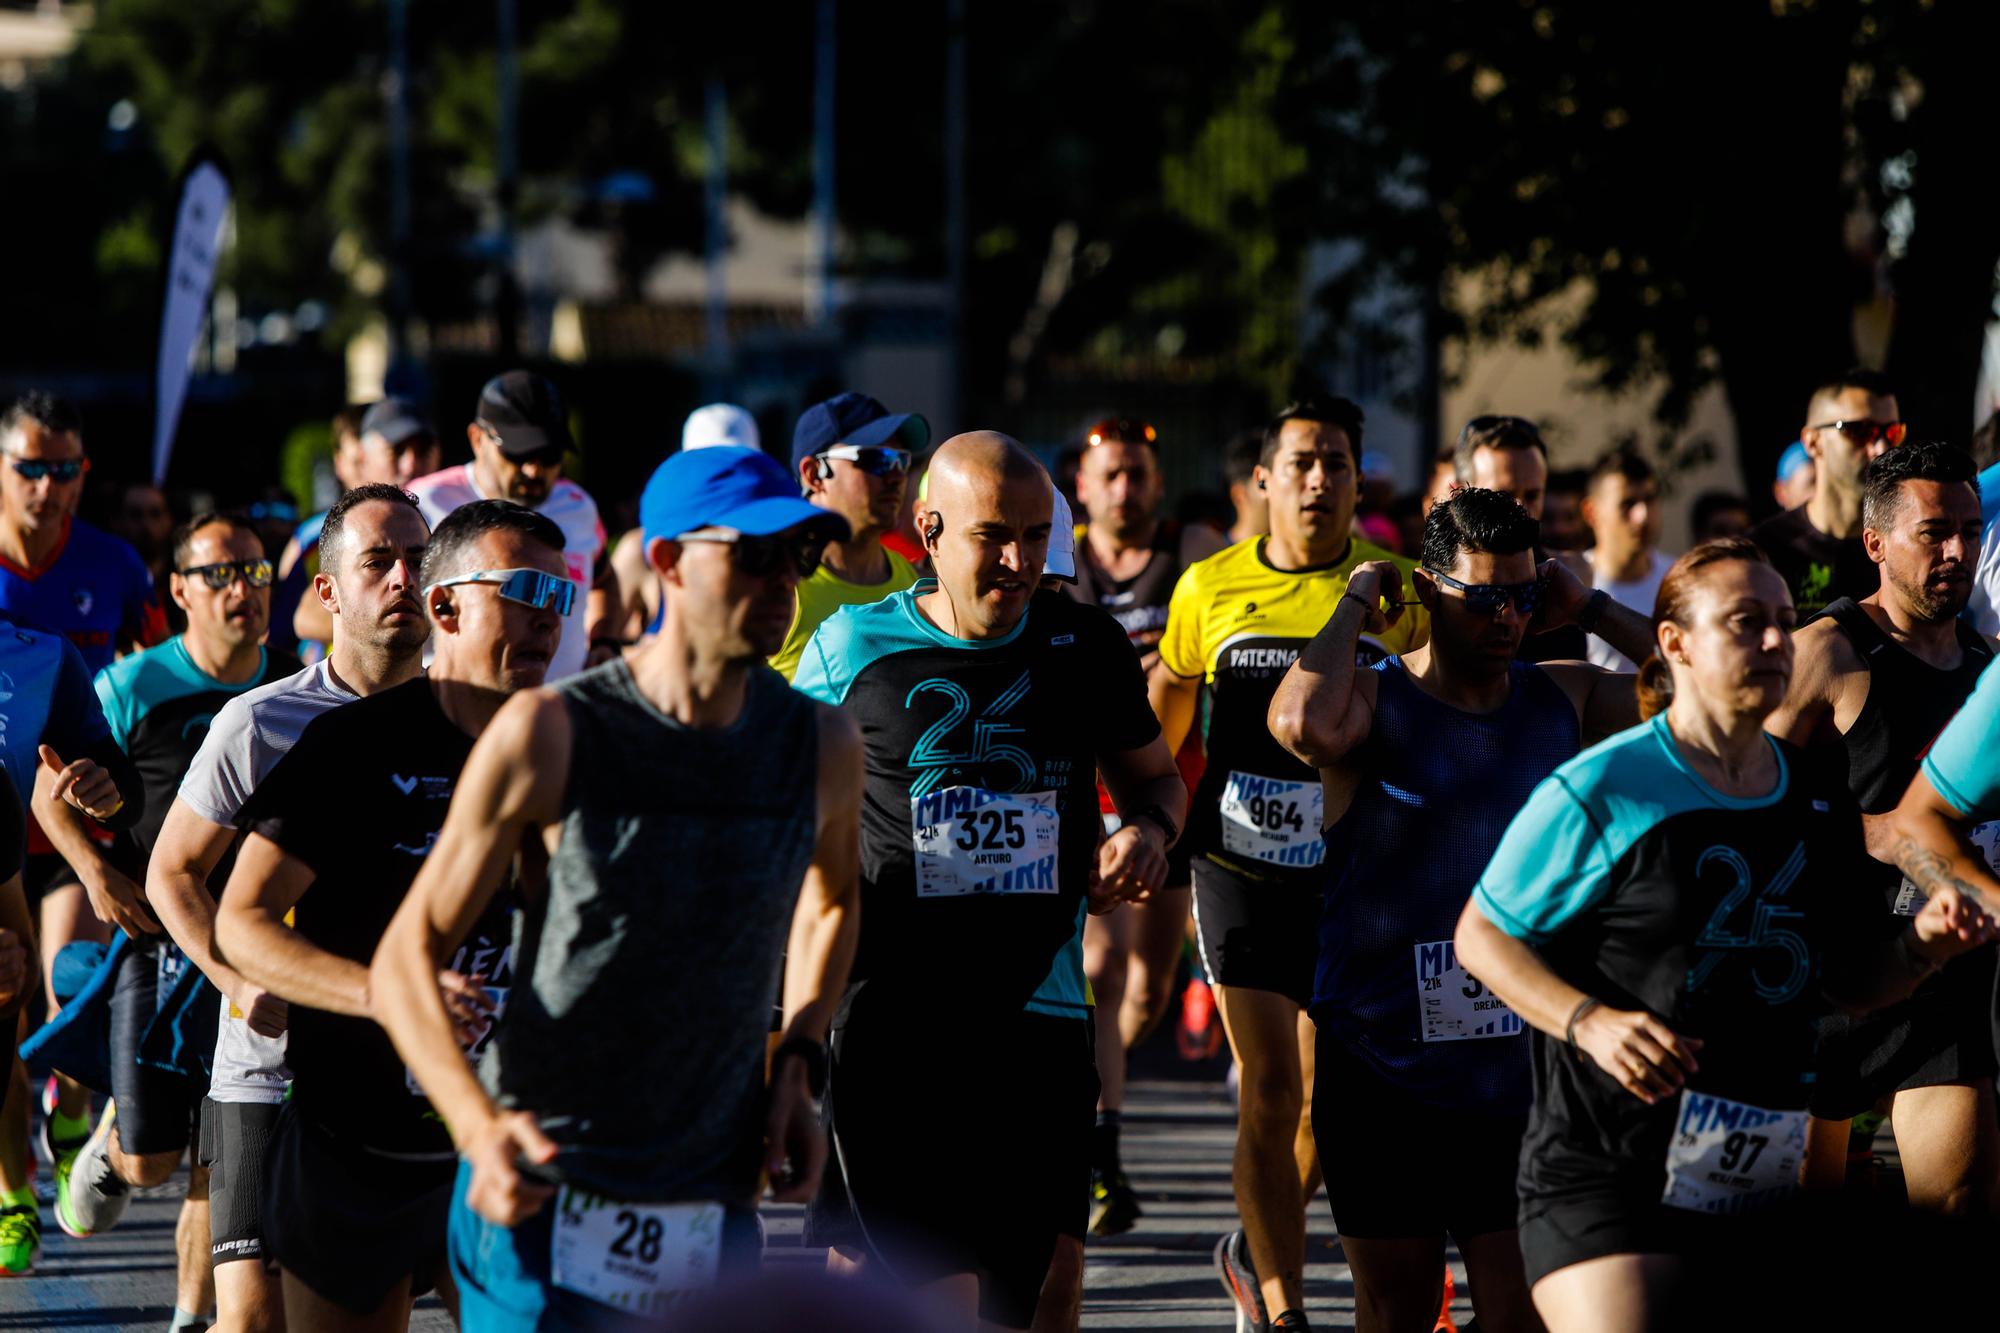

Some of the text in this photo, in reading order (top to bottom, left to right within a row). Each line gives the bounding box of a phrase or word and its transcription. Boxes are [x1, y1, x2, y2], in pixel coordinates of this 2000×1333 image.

[955, 810, 1025, 851] 325
[1250, 796, 1304, 833] 964
[974, 853, 1012, 865] ARTURO
[1720, 1131, 1769, 1174] 97
[610, 1211, 663, 1265] 28
